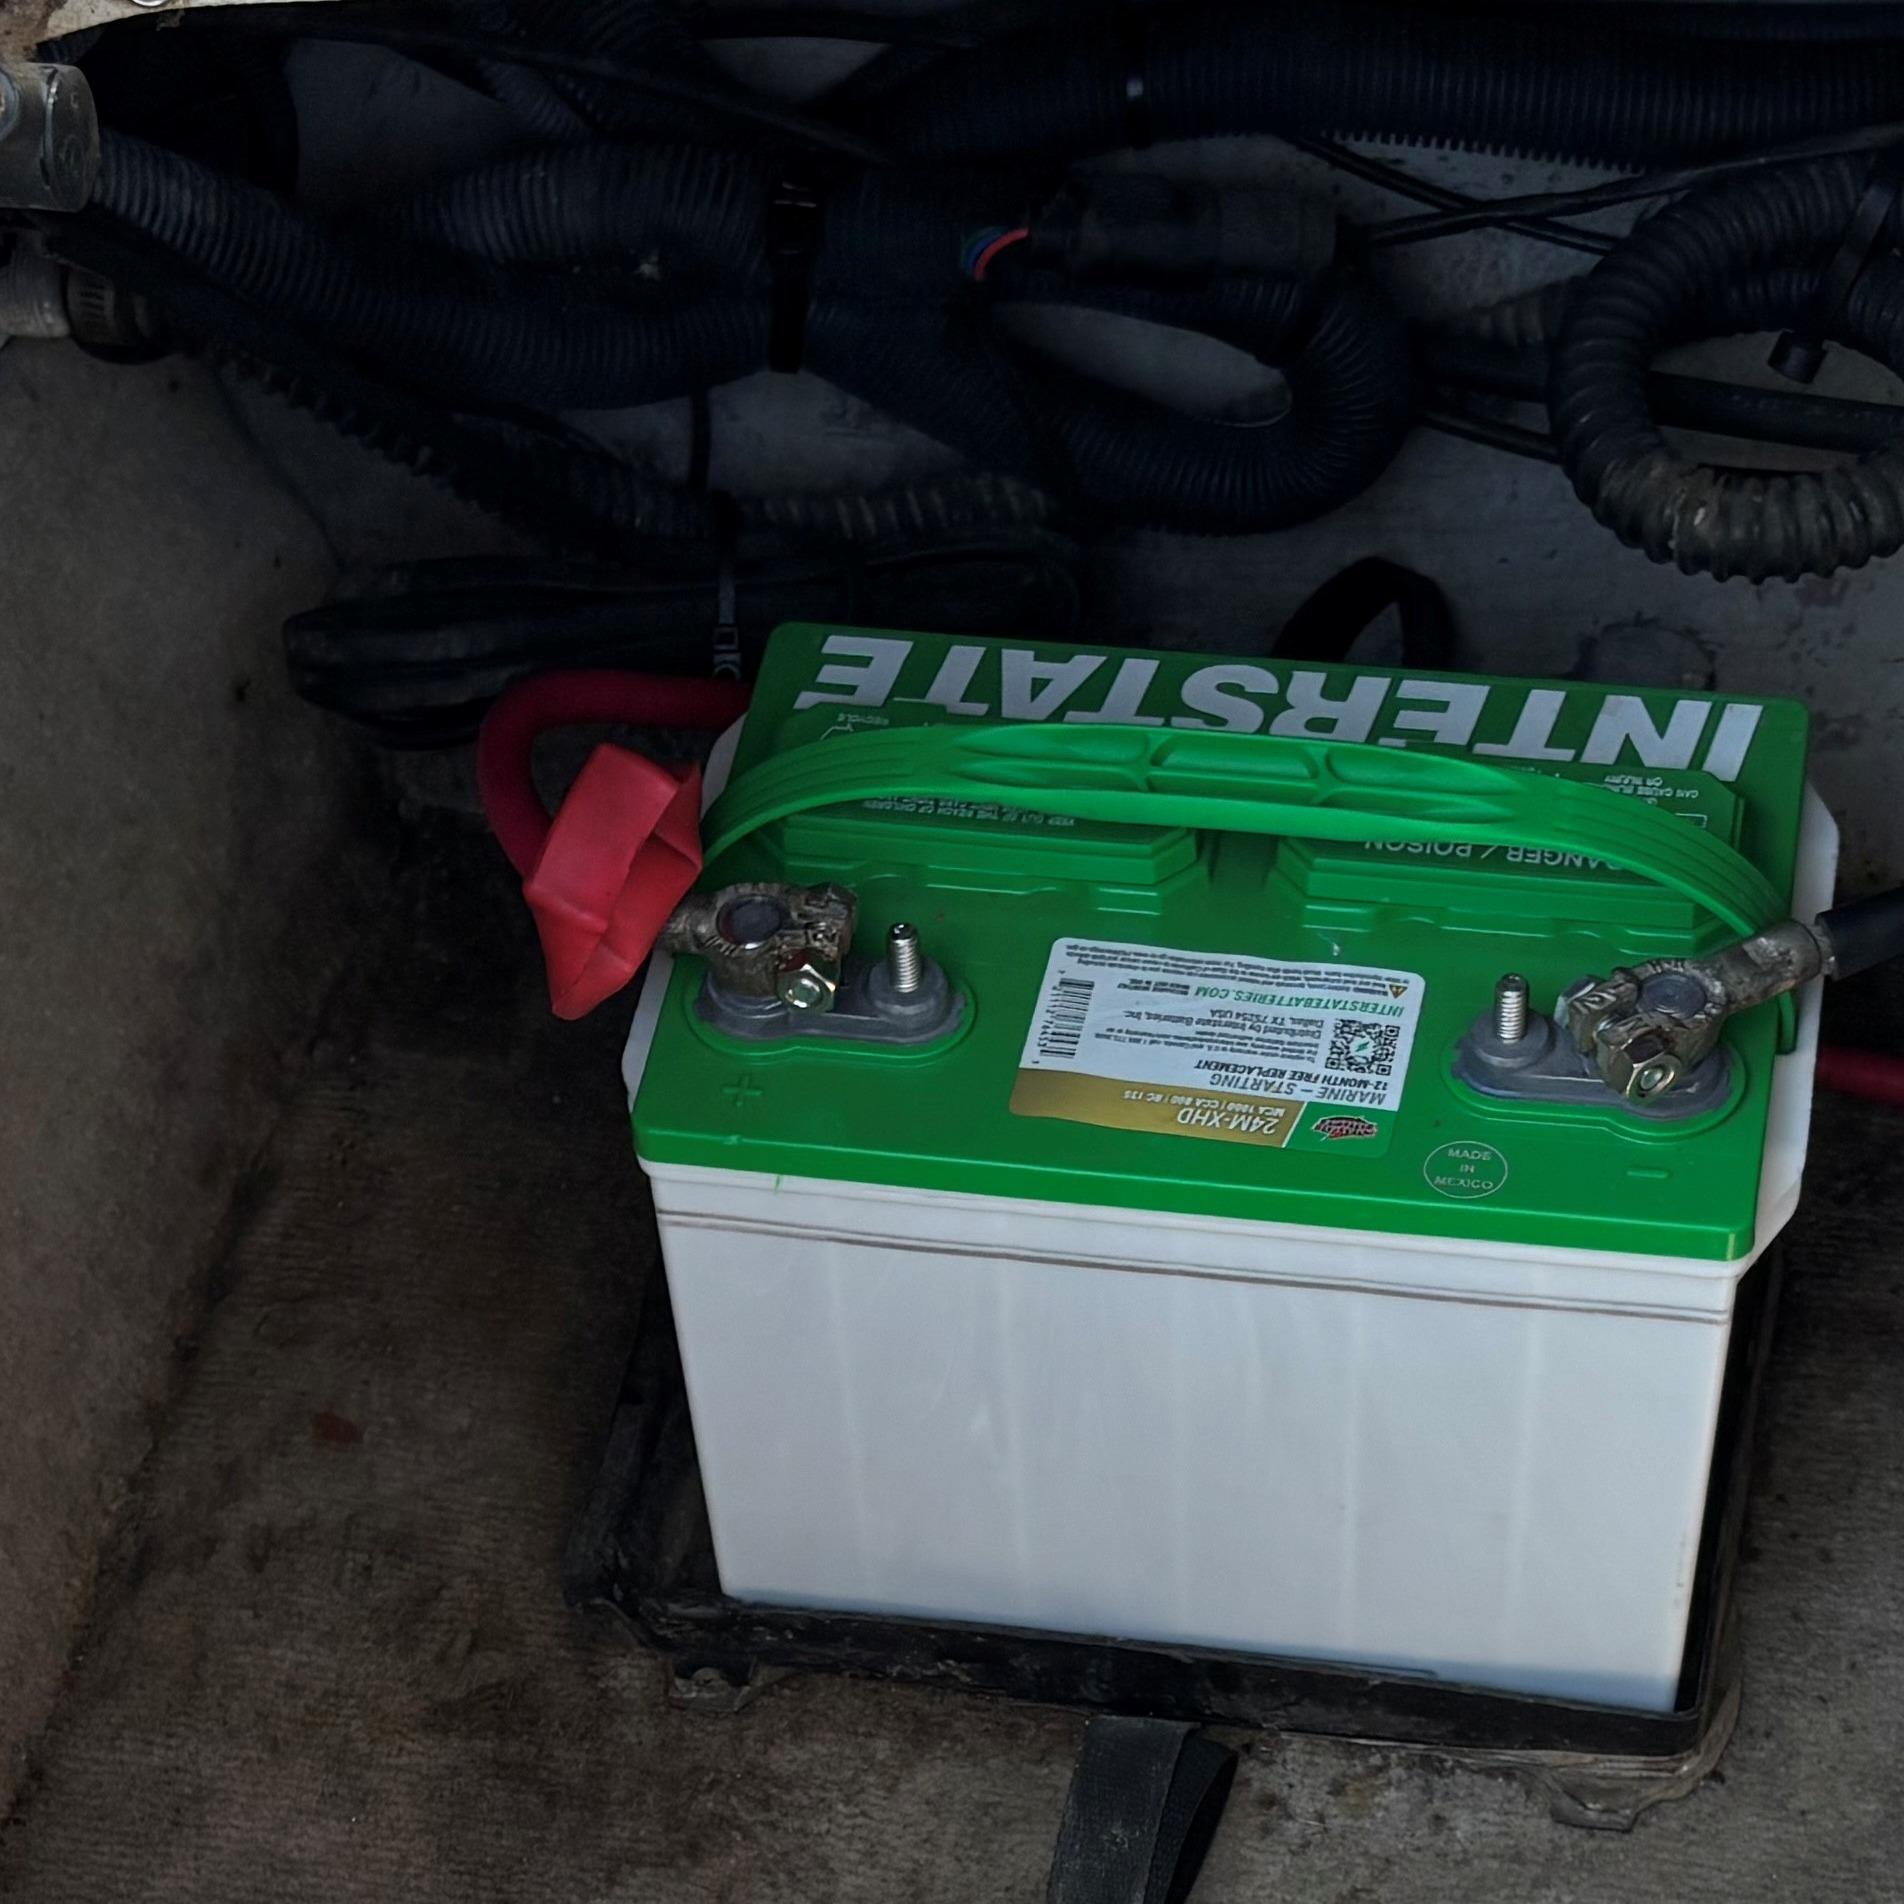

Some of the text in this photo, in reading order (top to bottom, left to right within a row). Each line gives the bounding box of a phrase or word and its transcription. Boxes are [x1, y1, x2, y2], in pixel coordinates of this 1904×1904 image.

[793, 634, 1764, 783] INTERSTATE
[1646, 776, 1663, 787] OR
[1636, 785, 1674, 798] CAUSE
[1675, 788, 1699, 799] CAN
[861, 801, 917, 813] CHILDREN
[918, 804, 935, 814] OF
[936, 807, 974, 819] REACH
[976, 810, 999, 822] THE
[1021, 814, 1044, 825] OUT
[1047, 816, 1075, 827] KEEP
[1195, 986, 1405, 1018] INTERSTATEBATTERIES.COM
[1208, 1008, 1233, 1020] USA
[1247, 1021, 1263, 1033] by
[1270, 1016, 1285, 1026] TX
[1193, 1060, 1389, 1091] 12-MONTH FREE REPLACEMENT
[1208, 1073, 1297, 1096] STARTING
[1122, 1089, 1143, 1100] 135
[1144, 1092, 1163, 1102] RC
[1315, 1086, 1387, 1106] MARINE
[1193, 1097, 1220, 1108] CCA
[1225, 1102, 1256, 1113] 1000
[1256, 1105, 1285, 1117] MCA
[1177, 1107, 1280, 1135] 24M-XHD
[1447, 1147, 1493, 1161] MADE
[1459, 1163, 1476, 1174] IN
[1433, 1175, 1494, 1190] MEXICO
